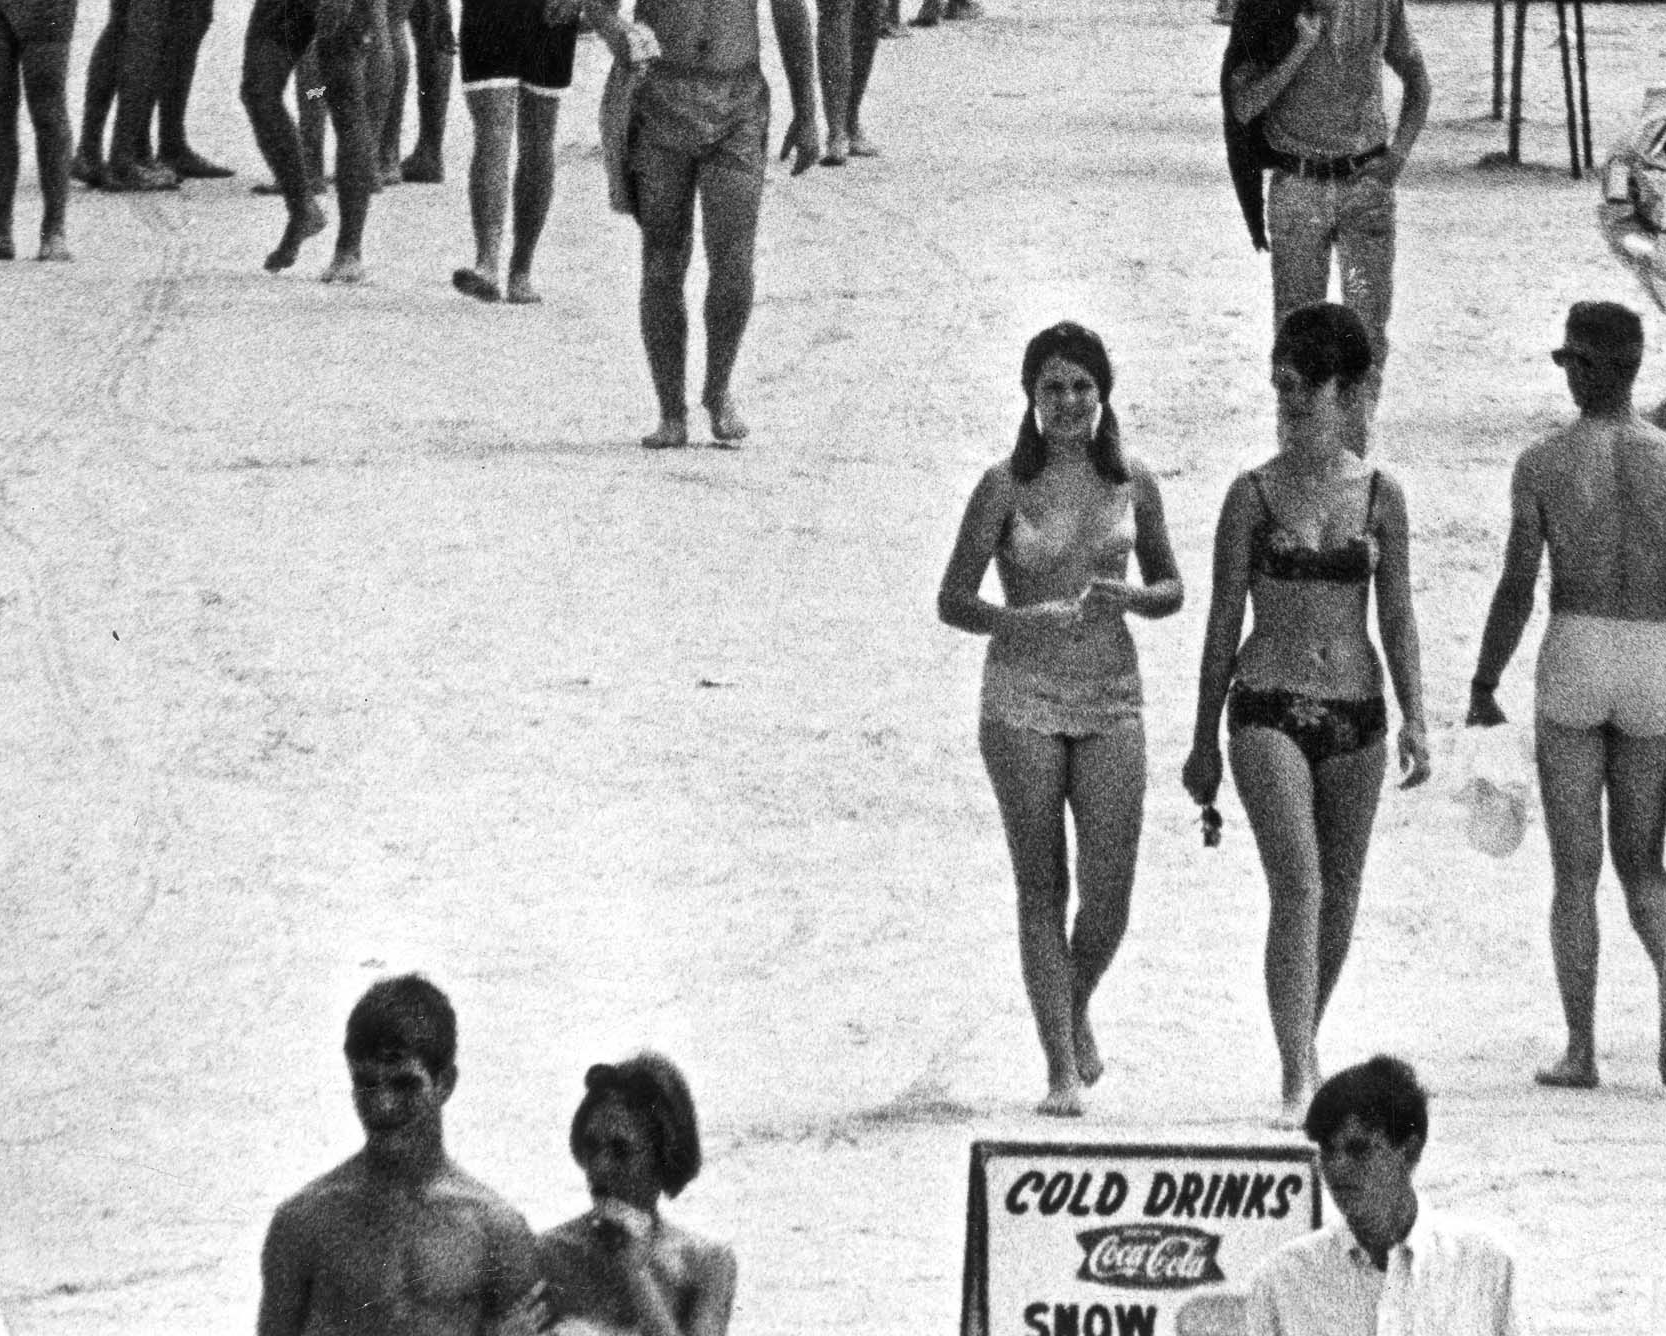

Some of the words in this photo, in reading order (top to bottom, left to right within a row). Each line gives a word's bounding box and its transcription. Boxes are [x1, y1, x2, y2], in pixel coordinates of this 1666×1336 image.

[1004, 1170, 1129, 1217] COLD
[1143, 1171, 1303, 1220] DRINKS
[1089, 1234, 1210, 1279] Coca-Cola
[1023, 1301, 1159, 1336] SNOW
